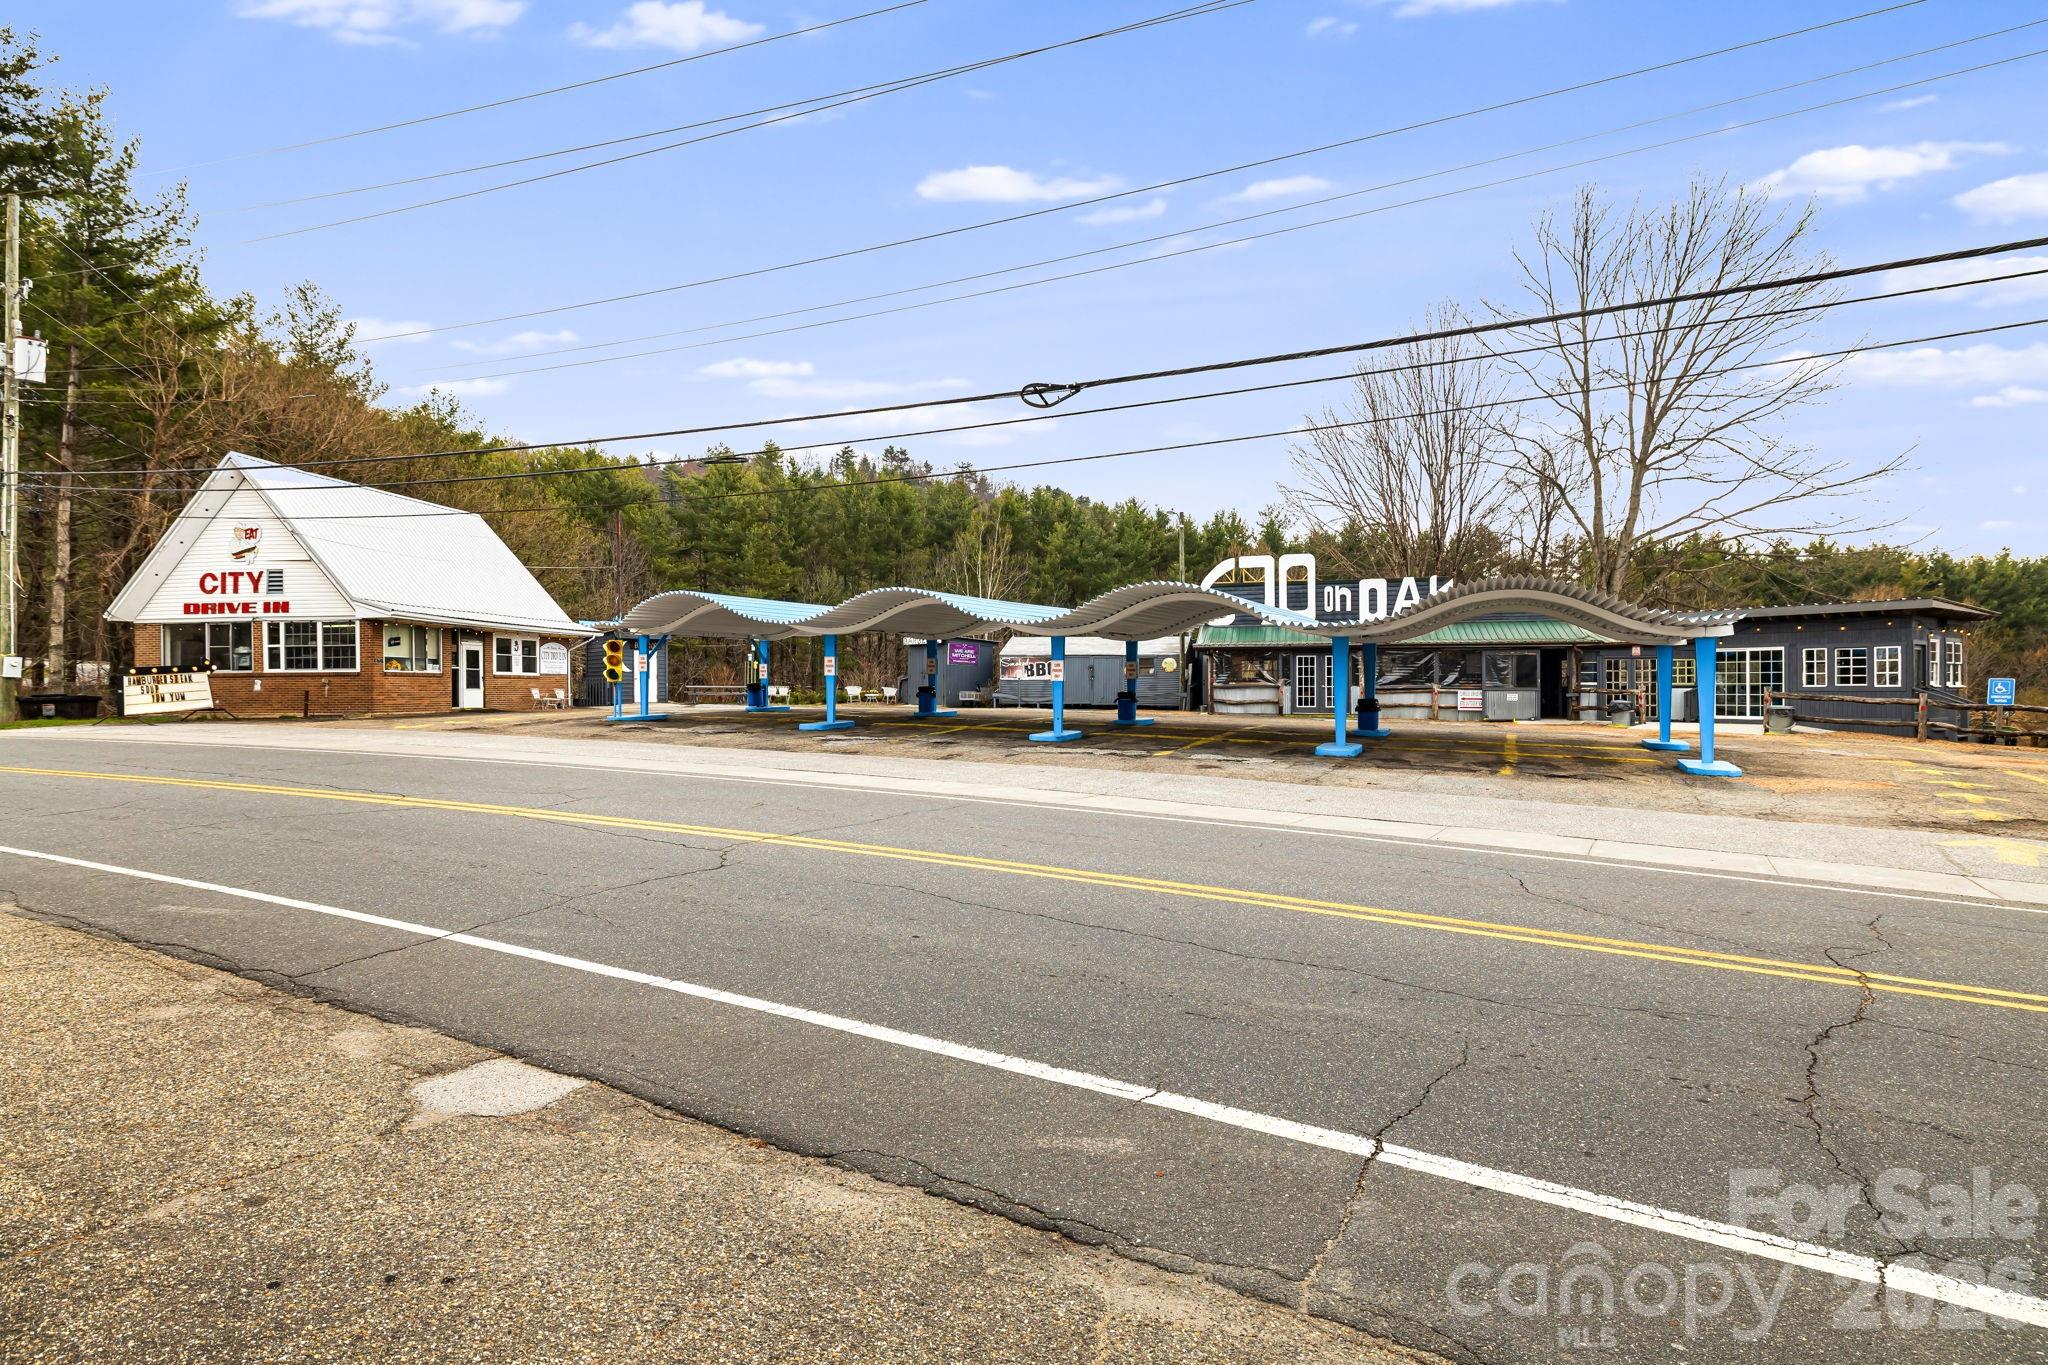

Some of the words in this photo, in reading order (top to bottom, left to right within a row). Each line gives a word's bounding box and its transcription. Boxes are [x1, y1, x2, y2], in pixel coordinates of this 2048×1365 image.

[244, 527, 259, 540] EAT
[199, 570, 264, 595] CITY
[1324, 585, 1352, 612] on
[183, 602, 258, 615] DRIVE
[263, 601, 290, 614] IN
[127, 675, 167, 686] HAMBURGER
[169, 674, 193, 683] STEAK
[140, 685, 160, 694] SOUP
[151, 694, 165, 703] TOM
[170, 692, 186, 702] YUM
